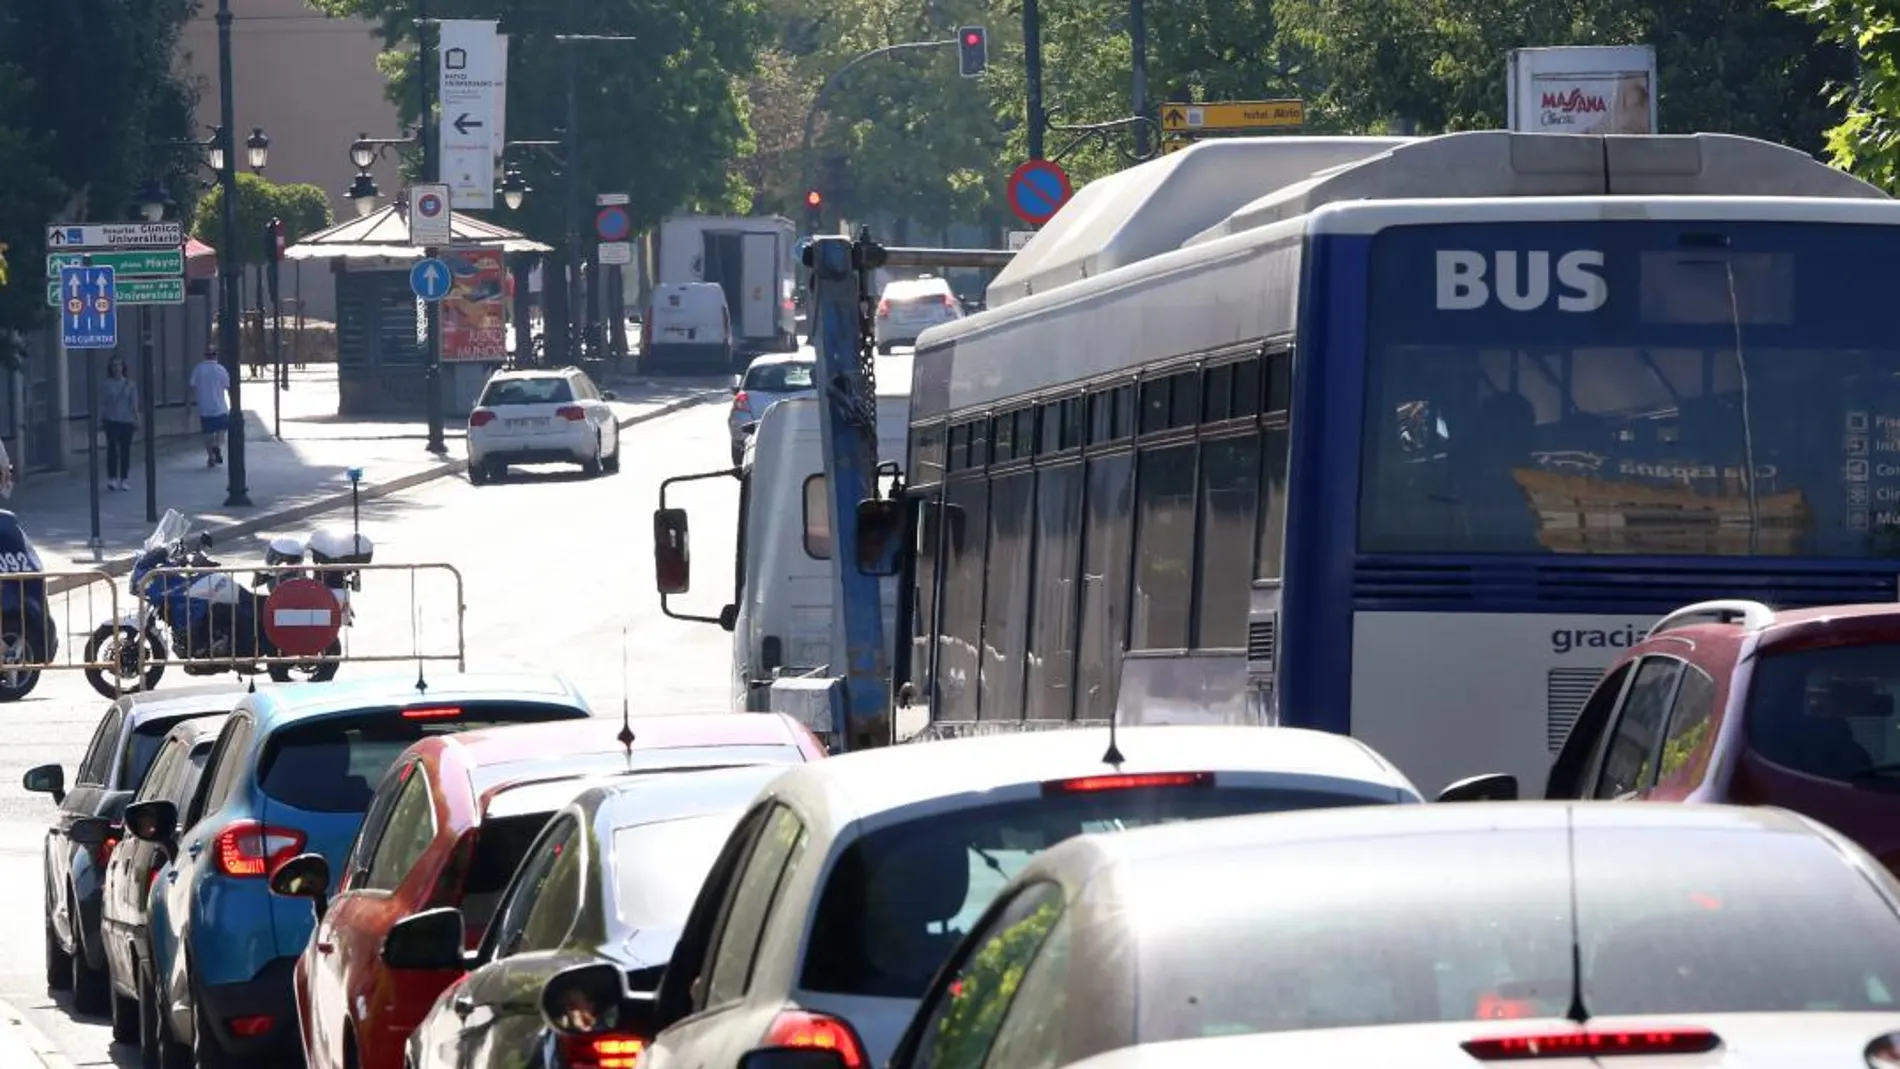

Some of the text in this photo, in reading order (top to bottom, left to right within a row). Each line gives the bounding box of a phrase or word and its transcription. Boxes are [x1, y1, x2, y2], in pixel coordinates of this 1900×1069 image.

[1541, 87, 1607, 113] MASSANA
[108, 233, 180, 244] Universitario
[145, 257, 180, 269] Mayor
[1435, 249, 1608, 313] BUS
[115, 289, 181, 300] Universidad
[0, 551, 32, 572] 092
